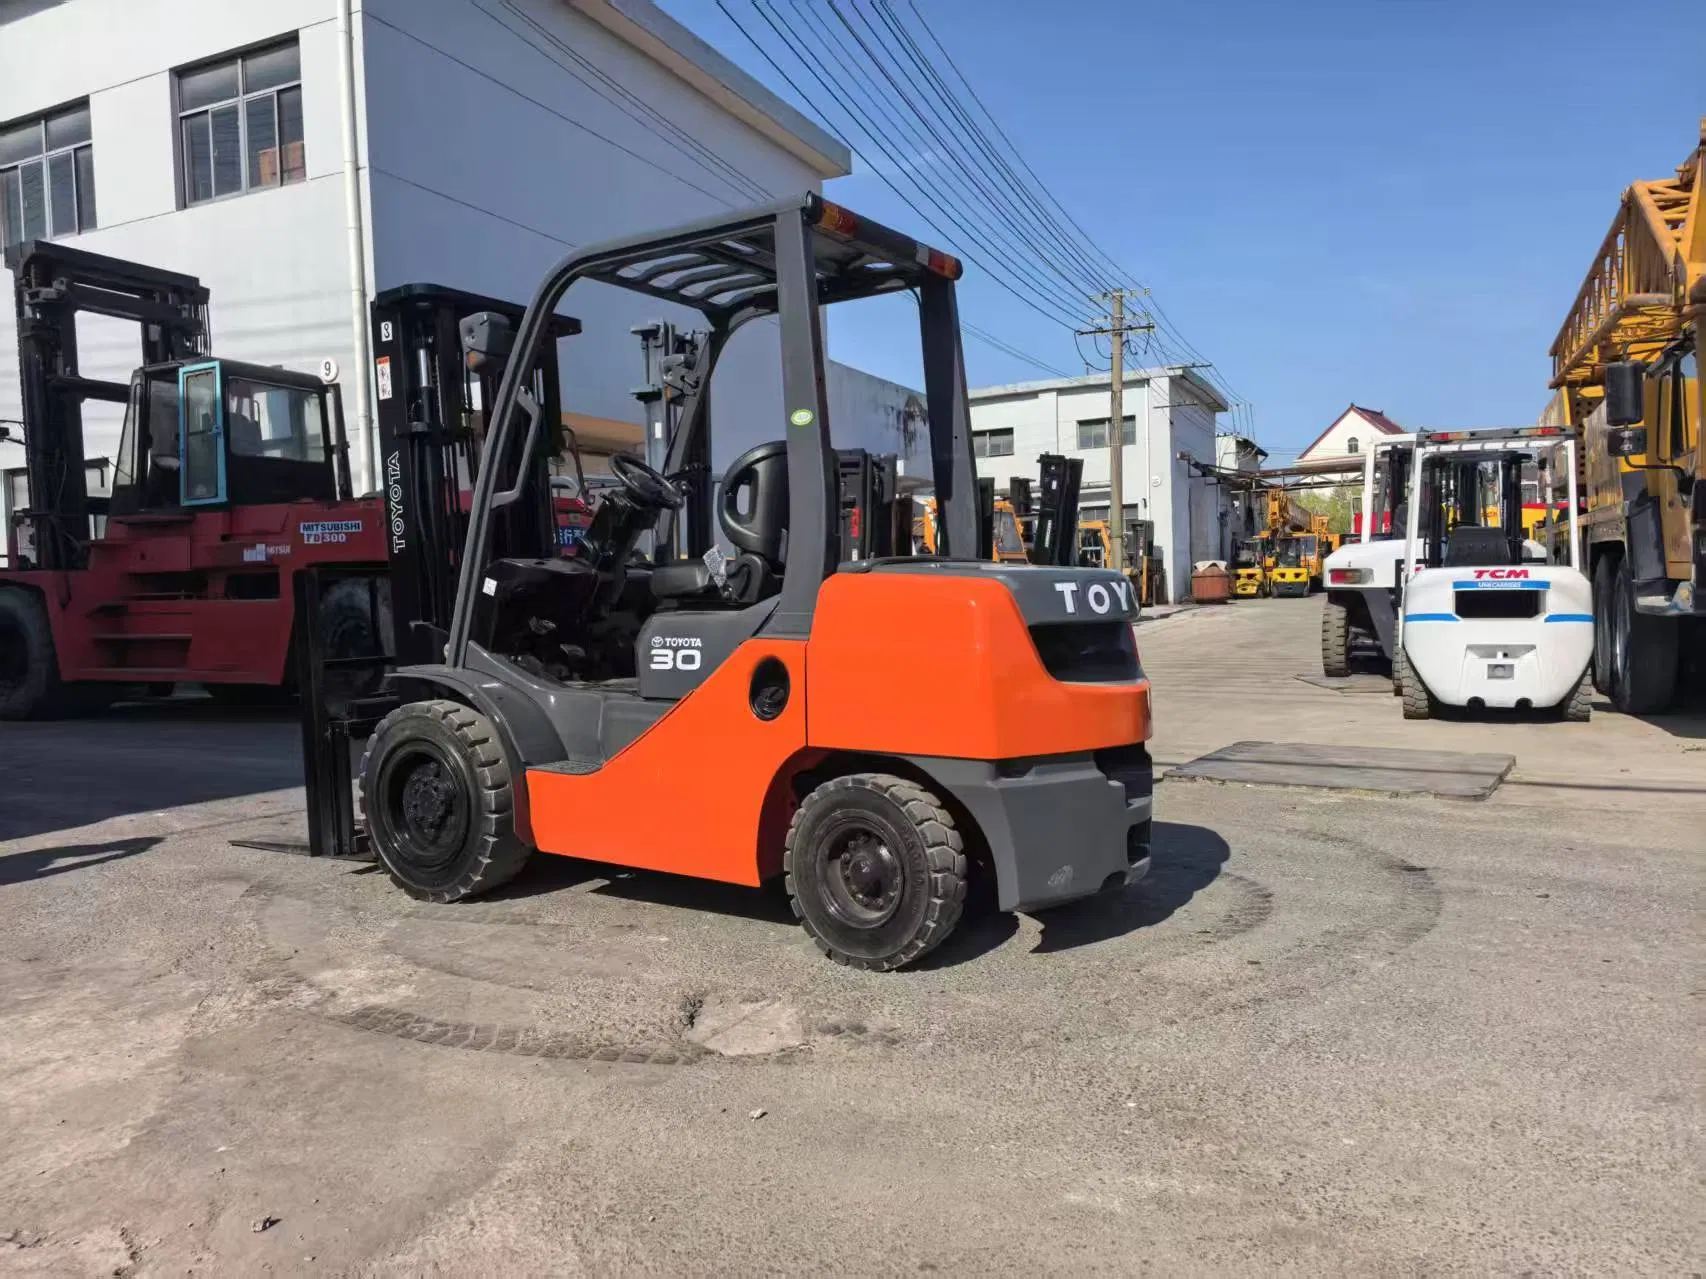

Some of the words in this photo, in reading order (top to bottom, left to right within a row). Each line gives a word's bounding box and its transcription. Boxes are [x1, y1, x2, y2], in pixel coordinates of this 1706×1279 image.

[324, 361, 331, 376] 9
[387, 450, 406, 554] TOYOTA
[302, 522, 361, 532] MITSUBISHI
[1473, 569, 1529, 579] TCM
[1054, 582, 1139, 615] TOY
[664, 637, 702, 647] TOYOTA
[650, 649, 701, 670] 30
